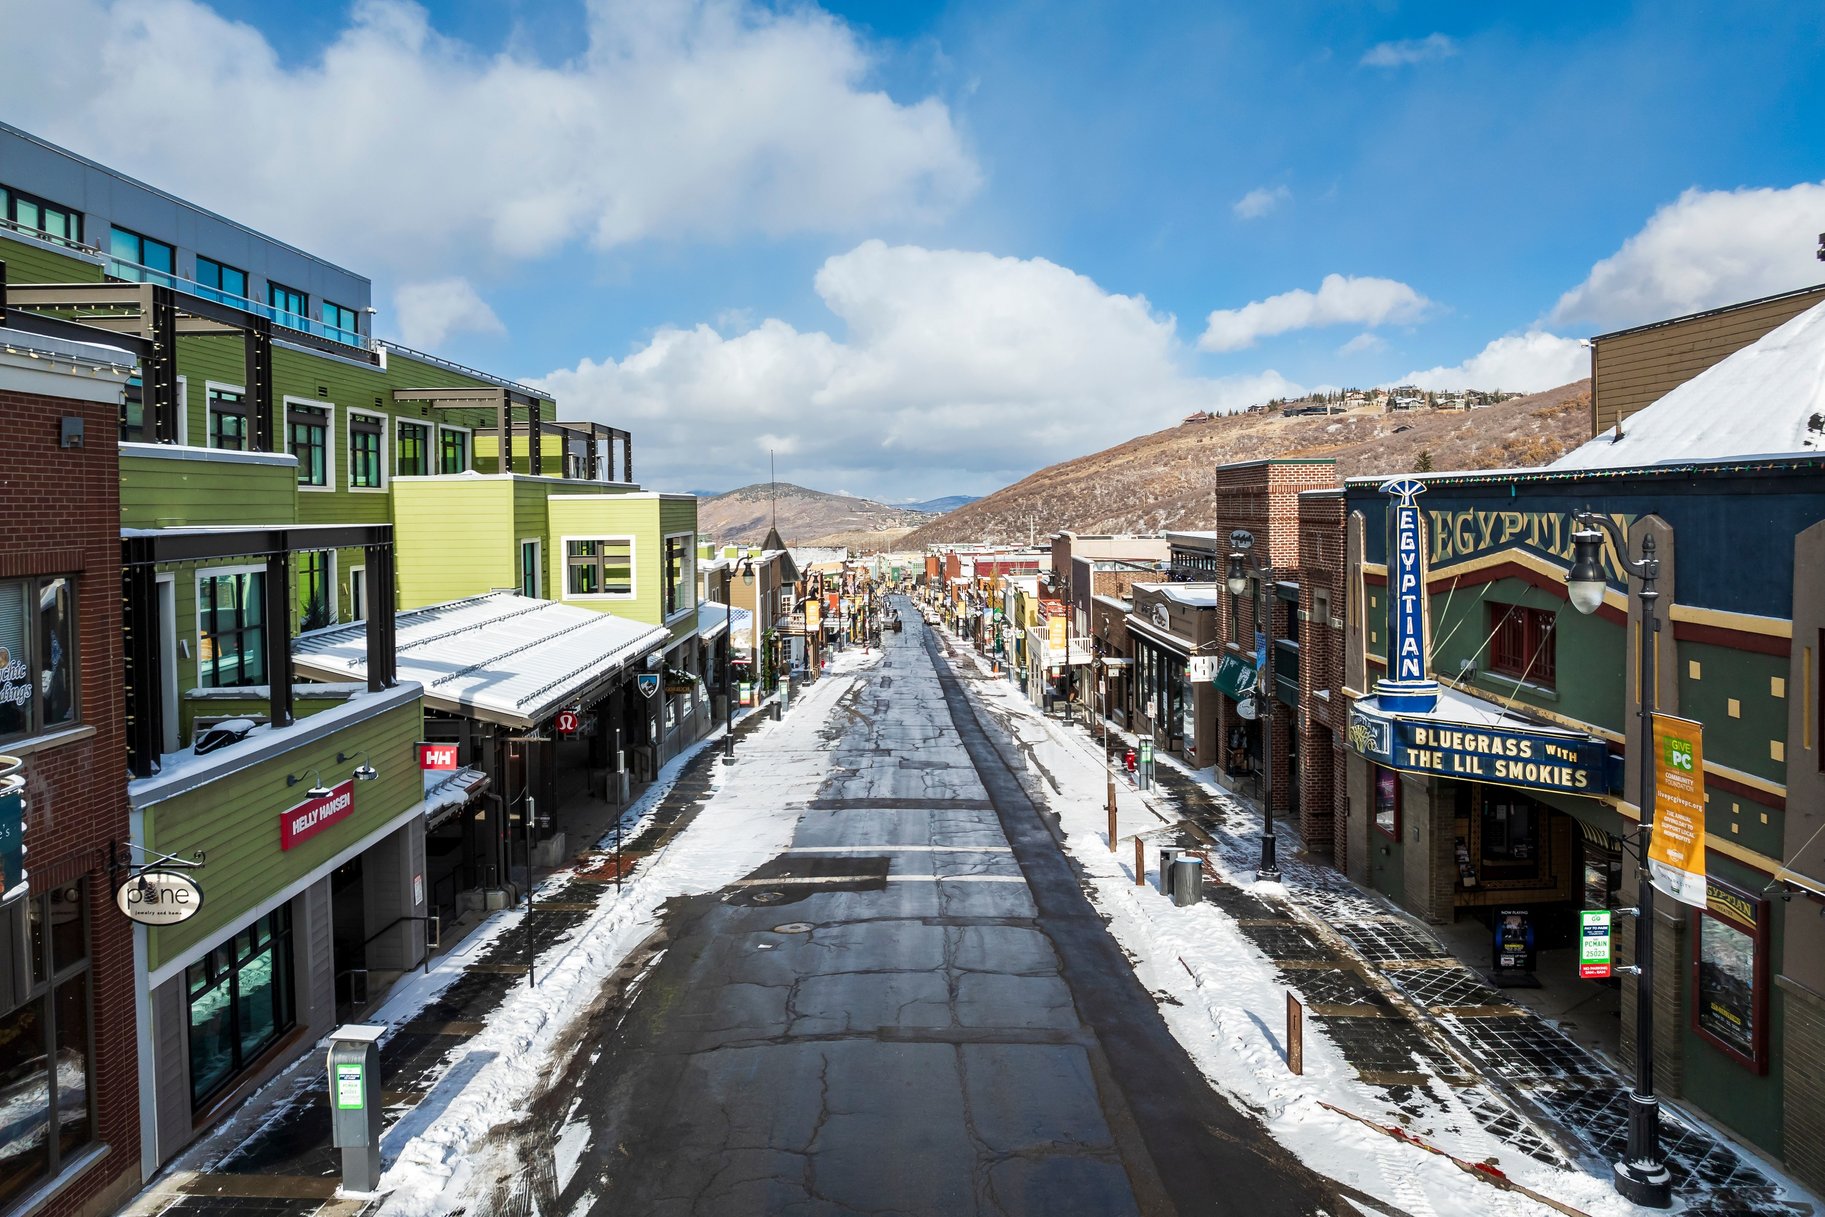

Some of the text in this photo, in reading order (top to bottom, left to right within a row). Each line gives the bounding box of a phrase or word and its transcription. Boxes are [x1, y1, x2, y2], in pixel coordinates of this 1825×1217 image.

[1400, 510, 1420, 677] EGYPTIAN
[0, 660, 27, 682] chic
[1415, 727, 1578, 763] BLUEGRASS WITH
[1671, 740, 1691, 753] GIVE
[1407, 749, 1588, 788] THE LIL SMOKIES
[1672, 750, 1692, 769] PC
[1665, 772, 1694, 785] COMMUNITY
[1665, 779, 1694, 792] FOUNDATION
[292, 792, 351, 836] HELLY HANSEN
[1706, 884, 1752, 918] GYPTIAN
